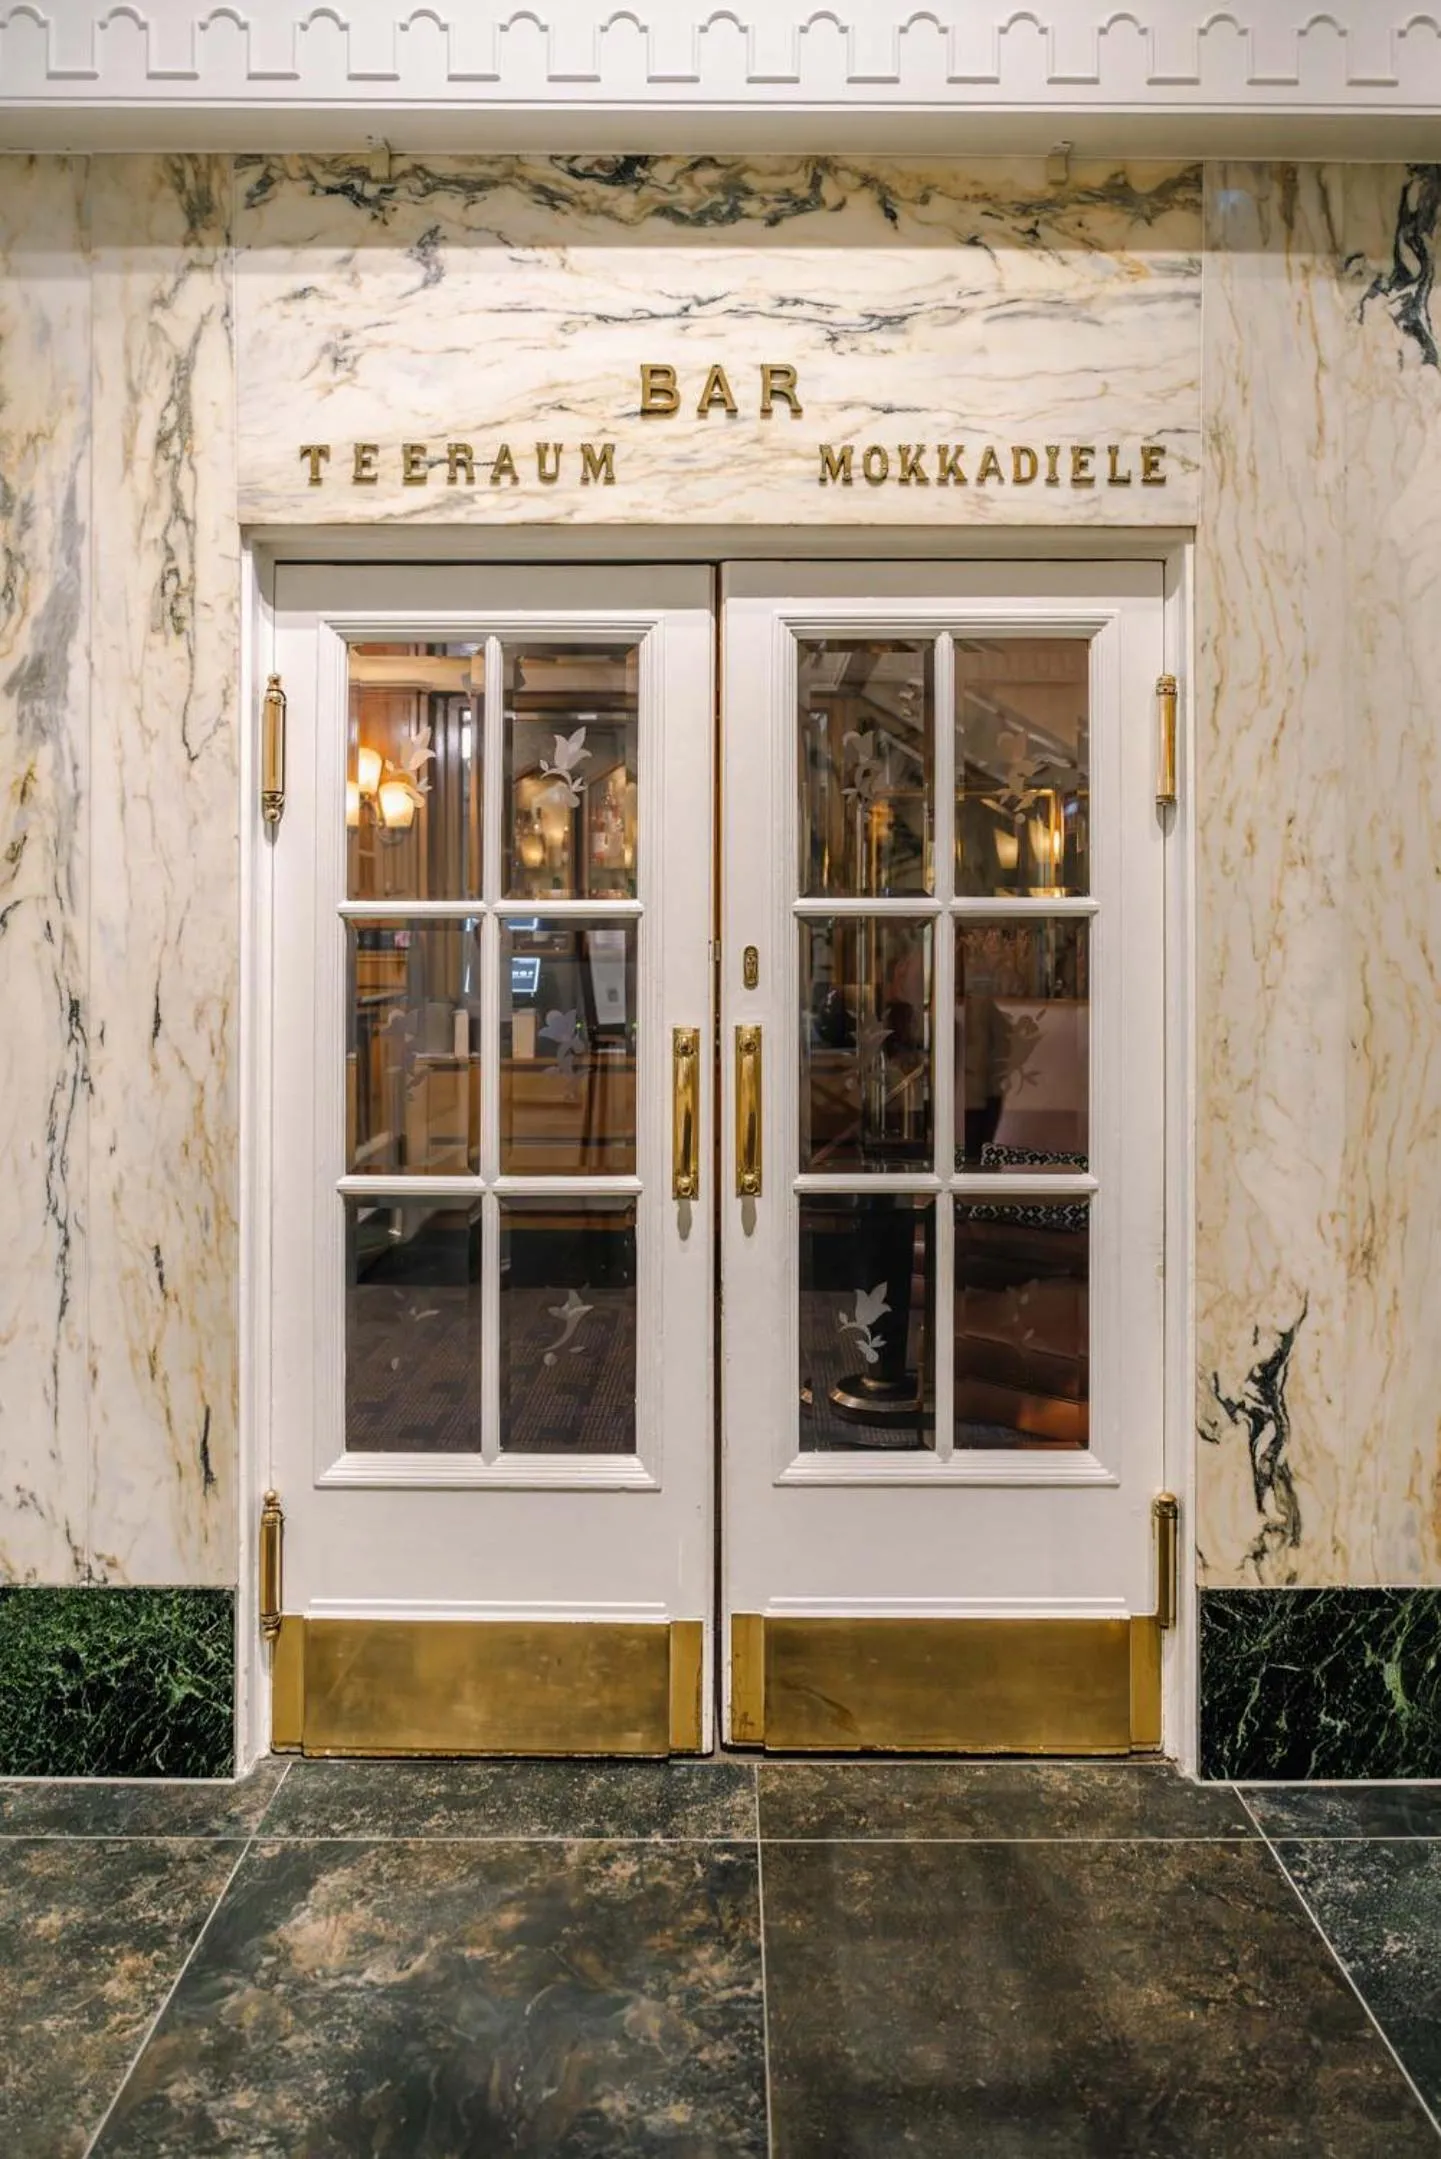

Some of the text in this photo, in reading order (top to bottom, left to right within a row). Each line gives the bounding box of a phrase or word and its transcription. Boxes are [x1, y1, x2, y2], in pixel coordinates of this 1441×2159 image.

[641, 363, 803, 414] BAR
[300, 443, 616, 482] TEERAUM
[819, 443, 1167, 483] MOKKADIELE
